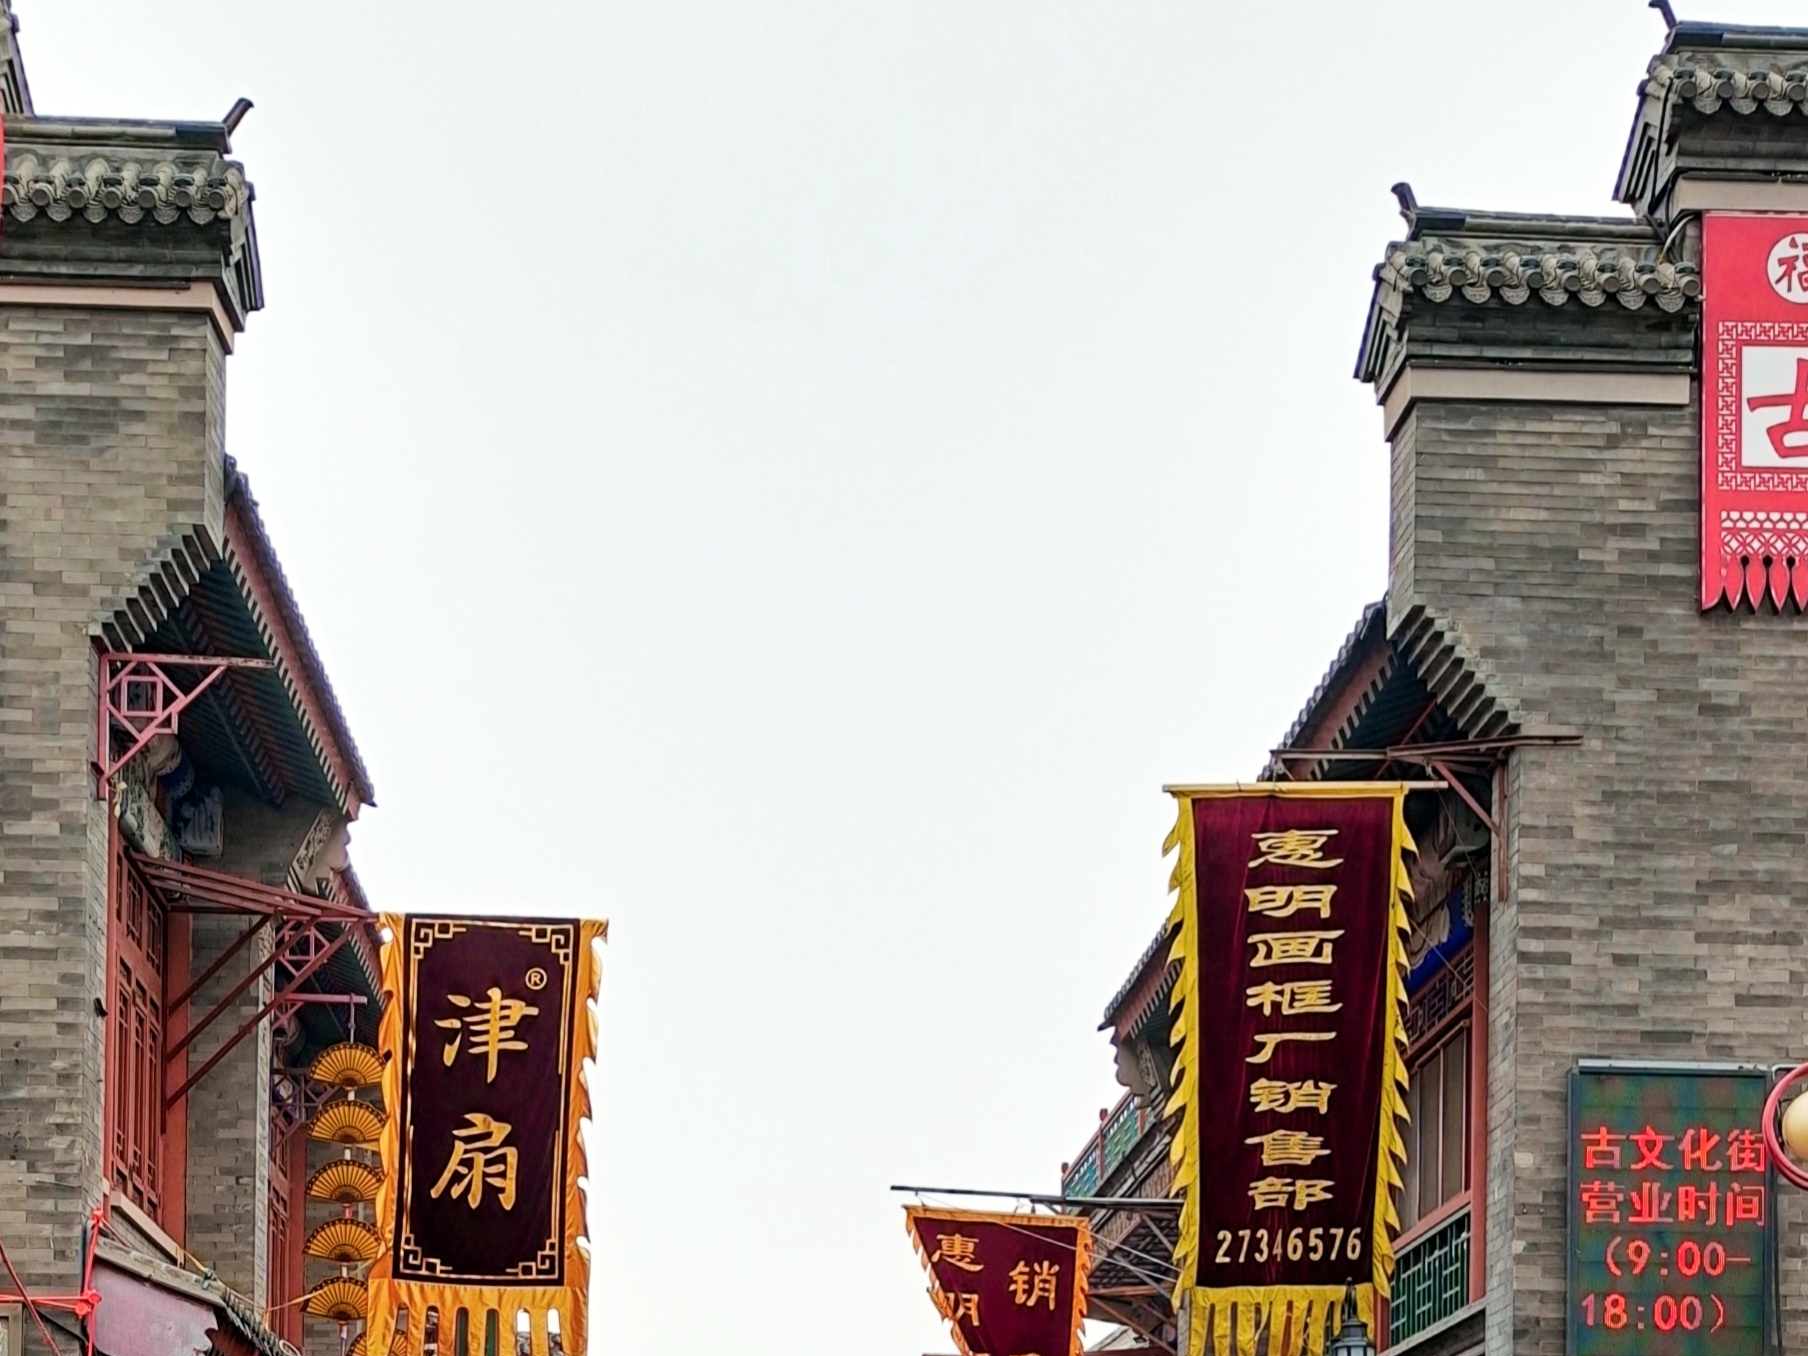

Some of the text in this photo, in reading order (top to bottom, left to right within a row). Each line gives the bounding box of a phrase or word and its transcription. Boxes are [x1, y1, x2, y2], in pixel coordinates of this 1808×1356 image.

[430, 986, 540, 1211] 津扇
[1580, 1125, 1766, 1172] 古文化街
[1580, 1181, 1765, 1227] 营业时间
[1215, 1227, 1362, 1263] 27346576
